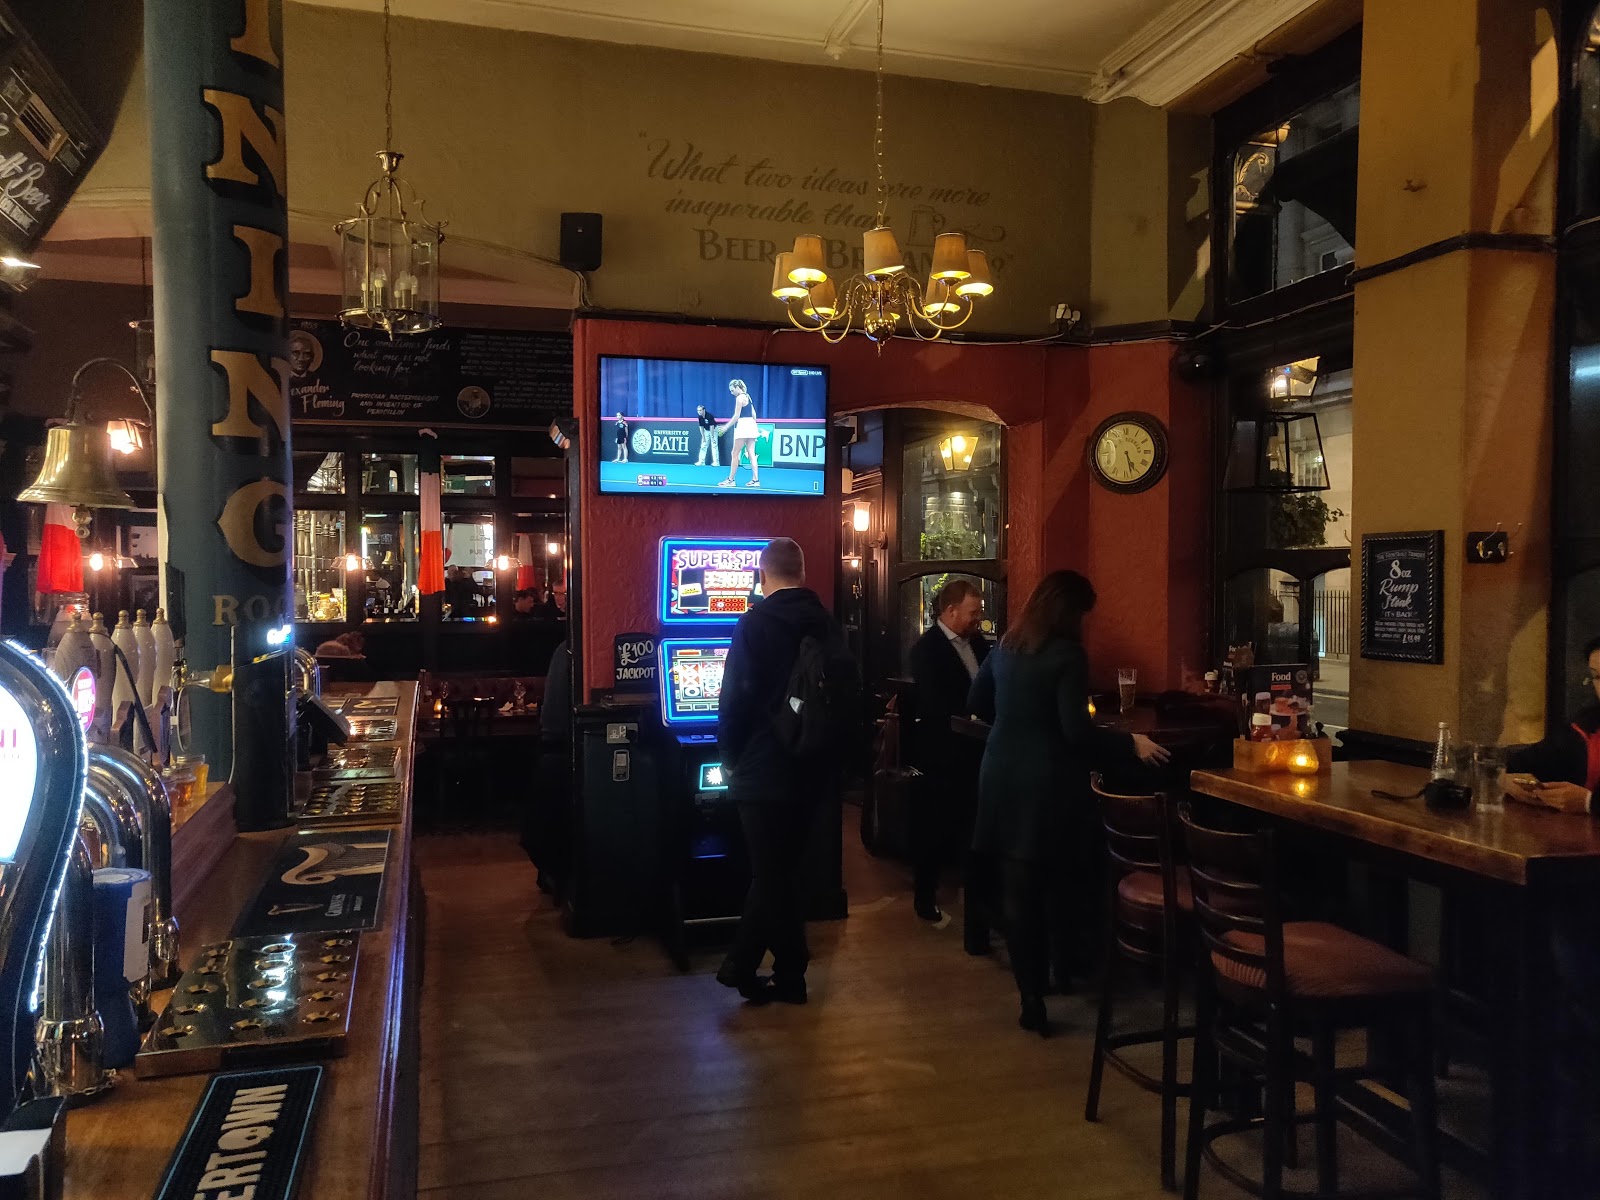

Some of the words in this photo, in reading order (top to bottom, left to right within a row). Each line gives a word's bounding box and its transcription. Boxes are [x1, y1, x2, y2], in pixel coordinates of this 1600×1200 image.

[4, 162, 51, 211] Beer
[744, 157, 793, 189] two
[802, 167, 868, 196] ideas
[928, 188, 990, 207] more
[421, 337, 451, 354] finds
[353, 350, 378, 360] what
[353, 361, 391, 377] looking
[301, 394, 345, 417] Fleming
[652, 435, 689, 452] BATH
[779, 434, 826, 459] BNP
[678, 551, 730, 569] SUPER
[1379, 578, 1420, 597] Rump
[1381, 595, 1413, 611] Steak
[618, 640, 654, 666] £100
[616, 667, 656, 681] JACKPOT
[1271, 671, 1292, 682] Food
